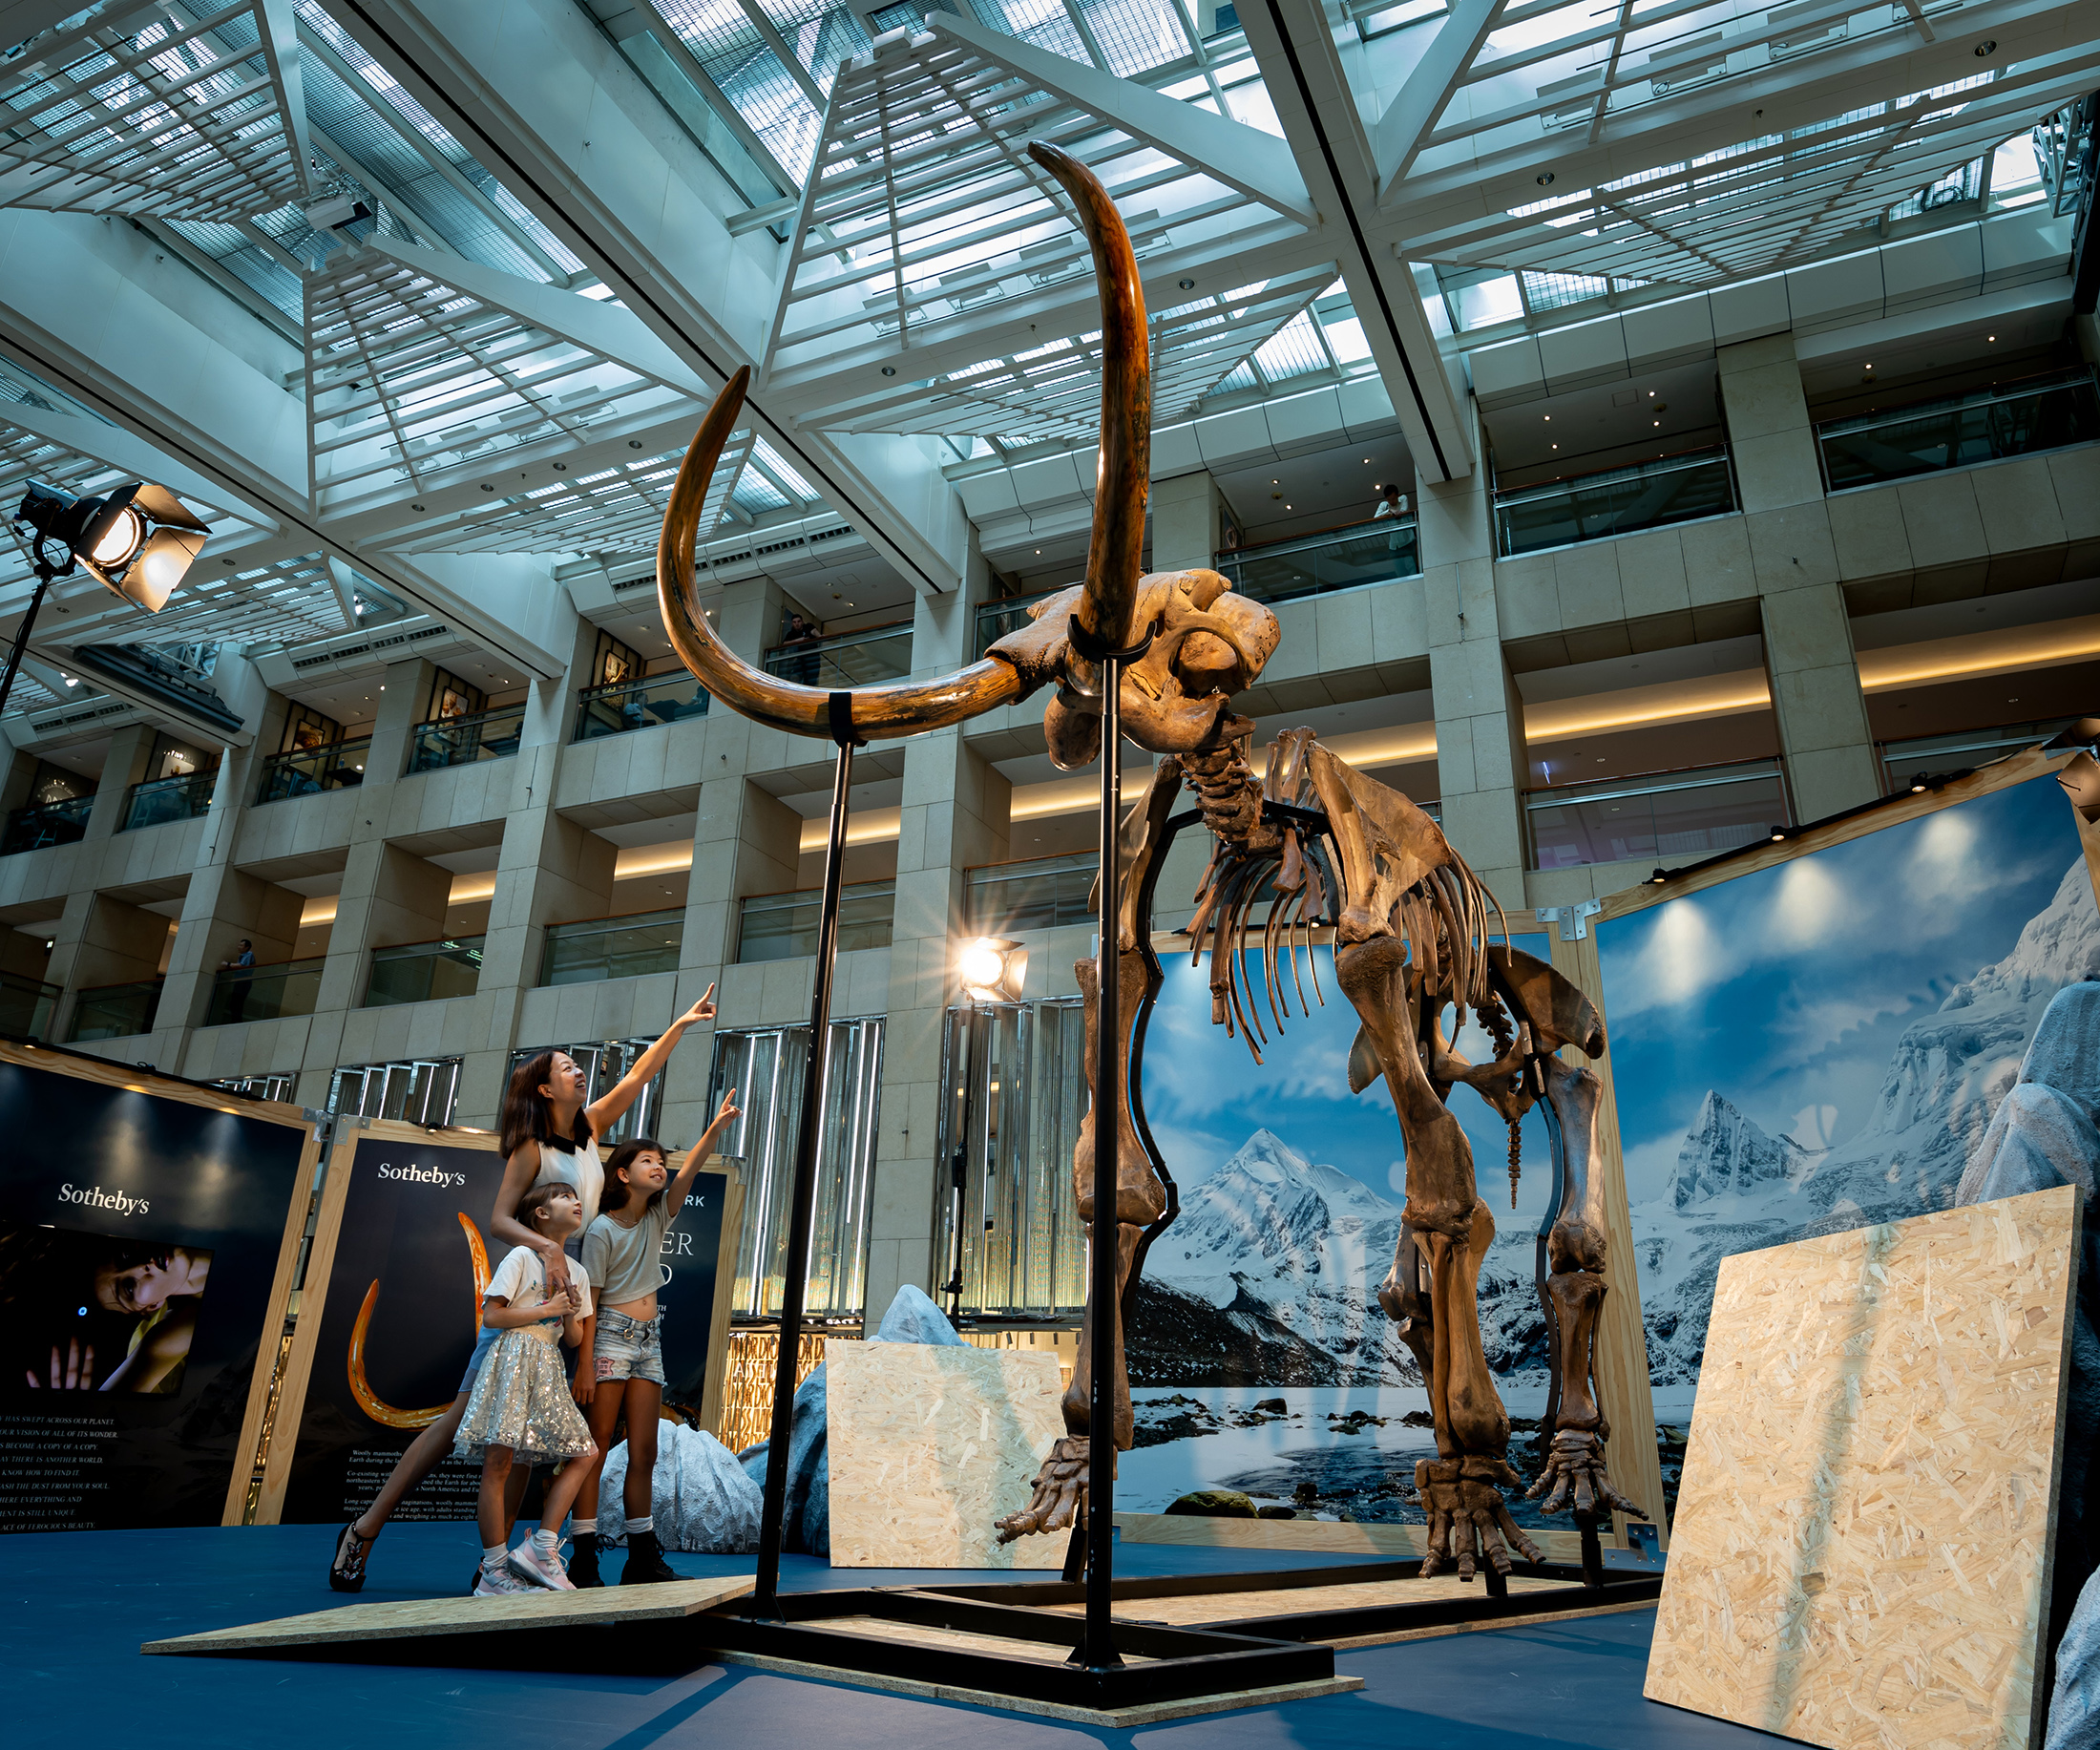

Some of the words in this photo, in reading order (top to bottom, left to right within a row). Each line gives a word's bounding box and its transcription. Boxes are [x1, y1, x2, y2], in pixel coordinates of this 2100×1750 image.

[377, 1163, 465, 1188] Sotheby's
[58, 1183, 149, 1216] Sotheby's
[346, 1469, 380, 1478] Co-existing
[345, 1497, 359, 1506] Long
